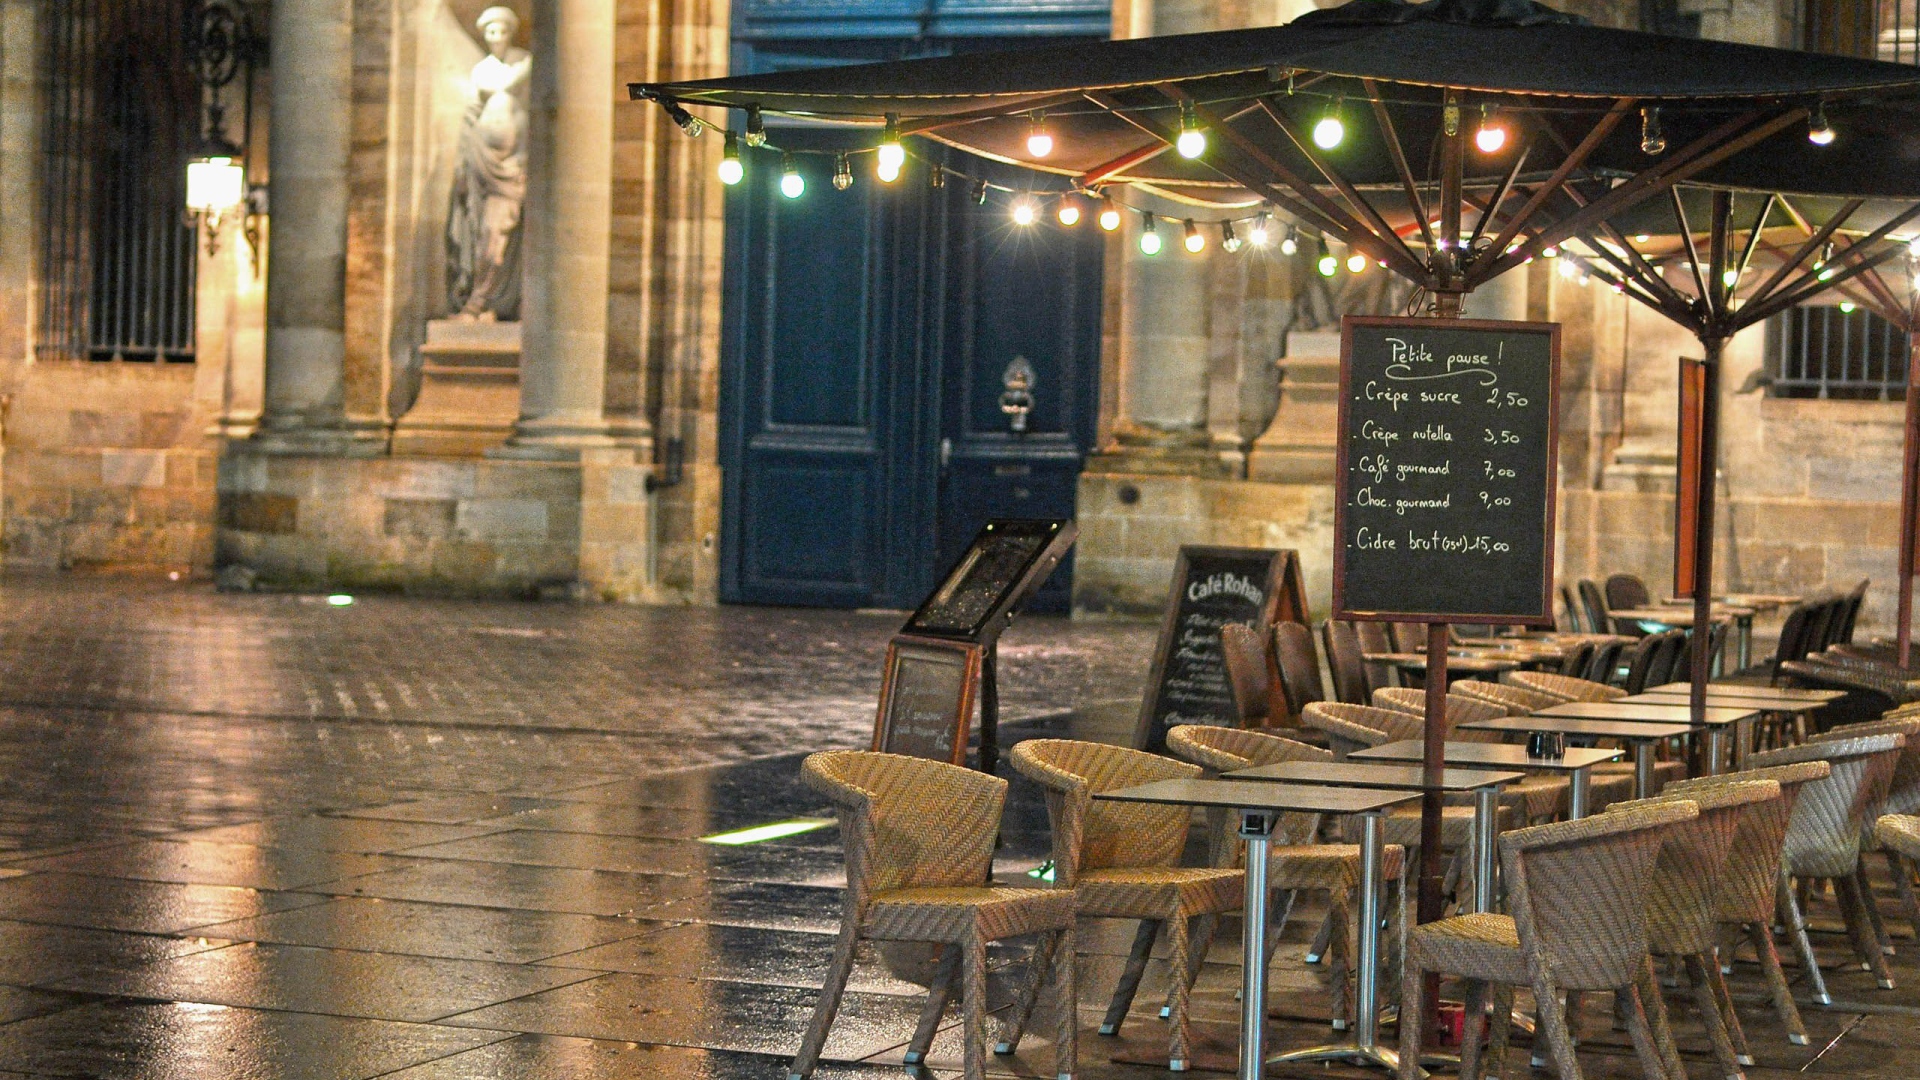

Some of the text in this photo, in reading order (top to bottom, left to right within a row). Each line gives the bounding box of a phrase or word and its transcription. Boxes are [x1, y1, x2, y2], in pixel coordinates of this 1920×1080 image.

[1386, 338, 1503, 372] Petite pause !
[1420, 393, 1462, 405] sucre
[1486, 388, 1529, 410] 2,50
[1412, 424, 1453, 442] nutella
[1484, 428, 1520, 446] 3,50
[1359, 454, 1516, 484] Café gourmand 7,00
[1357, 486, 1511, 515] Choc. gourmand 9,00
[1357, 527, 1397, 550] Cidre
[1409, 530, 1440, 551] brut
[1468, 536, 1510, 555] 15,00
[1188, 571, 1264, 606] Café Rohan
